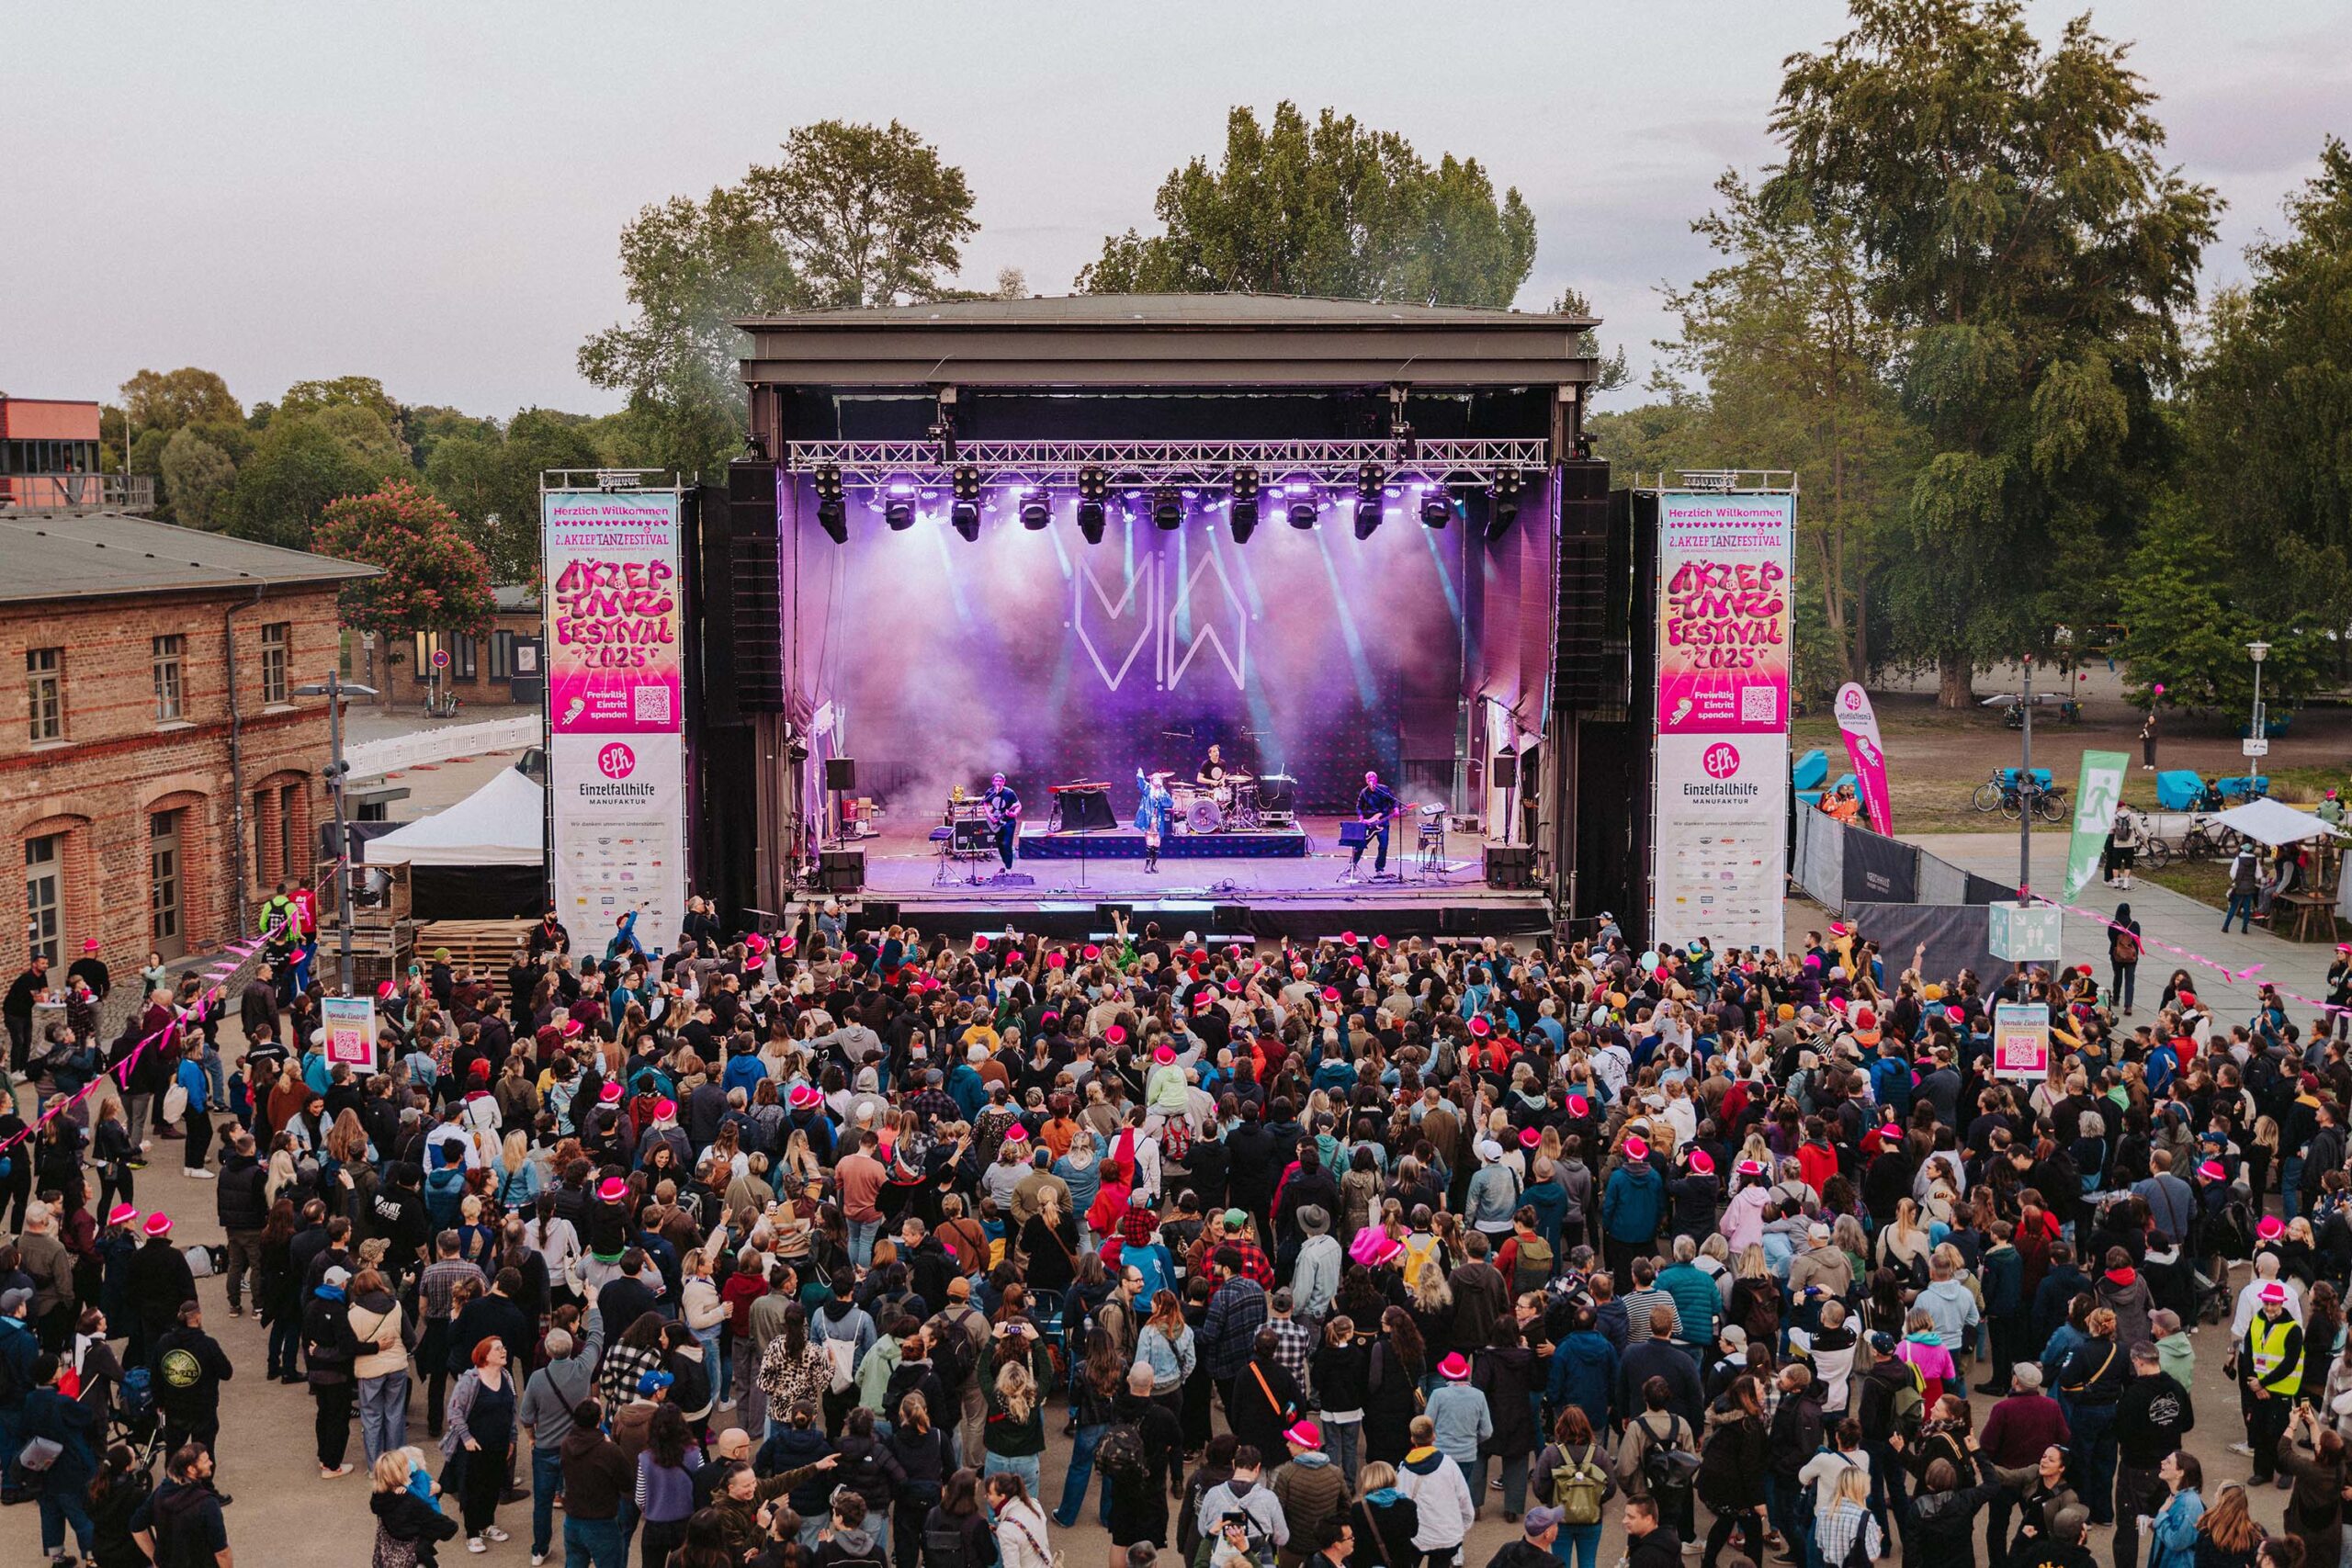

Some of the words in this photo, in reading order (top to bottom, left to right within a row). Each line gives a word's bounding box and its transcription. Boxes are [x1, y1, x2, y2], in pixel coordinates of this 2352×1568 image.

[553, 506, 597, 515] Herzlich
[602, 506, 669, 515] Willkommen
[1668, 508, 1712, 517] Herzlich
[1716, 508, 1782, 517] Willkommen
[555, 558, 673, 593] AKZEP
[1668, 559, 1784, 594] AKZEP
[557, 589, 673, 619] TANZ
[1668, 591, 1784, 620] TANZ
[557, 616, 674, 645] FESTIVAL
[1668, 618, 1783, 646] FESTIVAL
[584, 646, 646, 669] 2025
[1693, 646, 1755, 669] 2025
[587, 691, 628, 700] Freiwillig
[1694, 691, 1735, 700] Freiwillig
[596, 700, 628, 708] Eintritt
[1703, 701, 1735, 709] Eintritt
[590, 711, 628, 719] spenden
[1697, 711, 1734, 719] spenden
[580, 783, 655, 796] Einzelfallhilfe
[1683, 783, 1758, 796] Einzelfallhilfe
[1999, 1019, 2023, 1027] Spende
